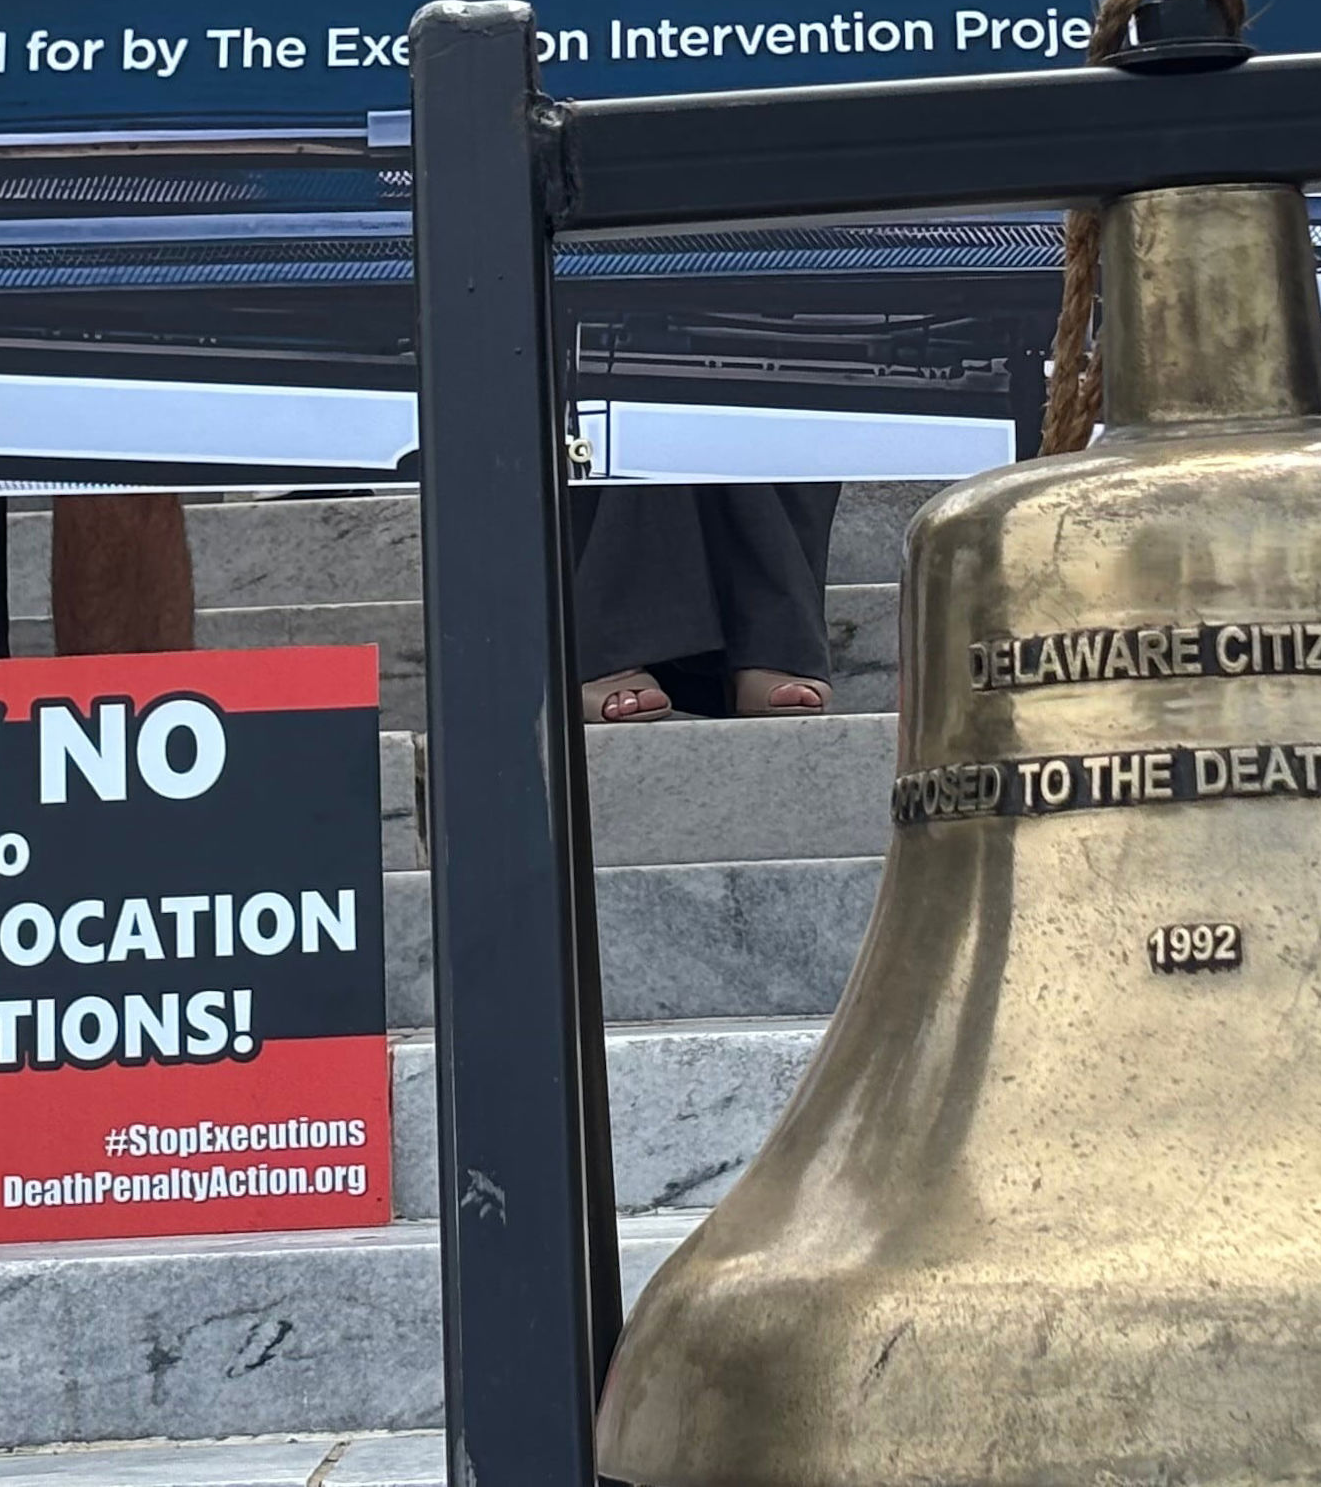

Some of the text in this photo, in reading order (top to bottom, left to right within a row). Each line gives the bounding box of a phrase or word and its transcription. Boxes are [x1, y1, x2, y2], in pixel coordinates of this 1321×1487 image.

[26, 29, 105, 72] for
[122, 28, 188, 77] by
[206, 27, 307, 70] The
[610, 11, 947, 61] Intervention
[972, 628, 1202, 690] DELAWARE
[39, 699, 227, 805] NO
[1017, 761, 1072, 807] TO
[1083, 753, 1174, 801] THE
[1147, 924, 1238, 964] 1992
[104, 1117, 366, 1158] #StopExecutions
[3, 1162, 367, 1210] DeathPenaltyAction.org
